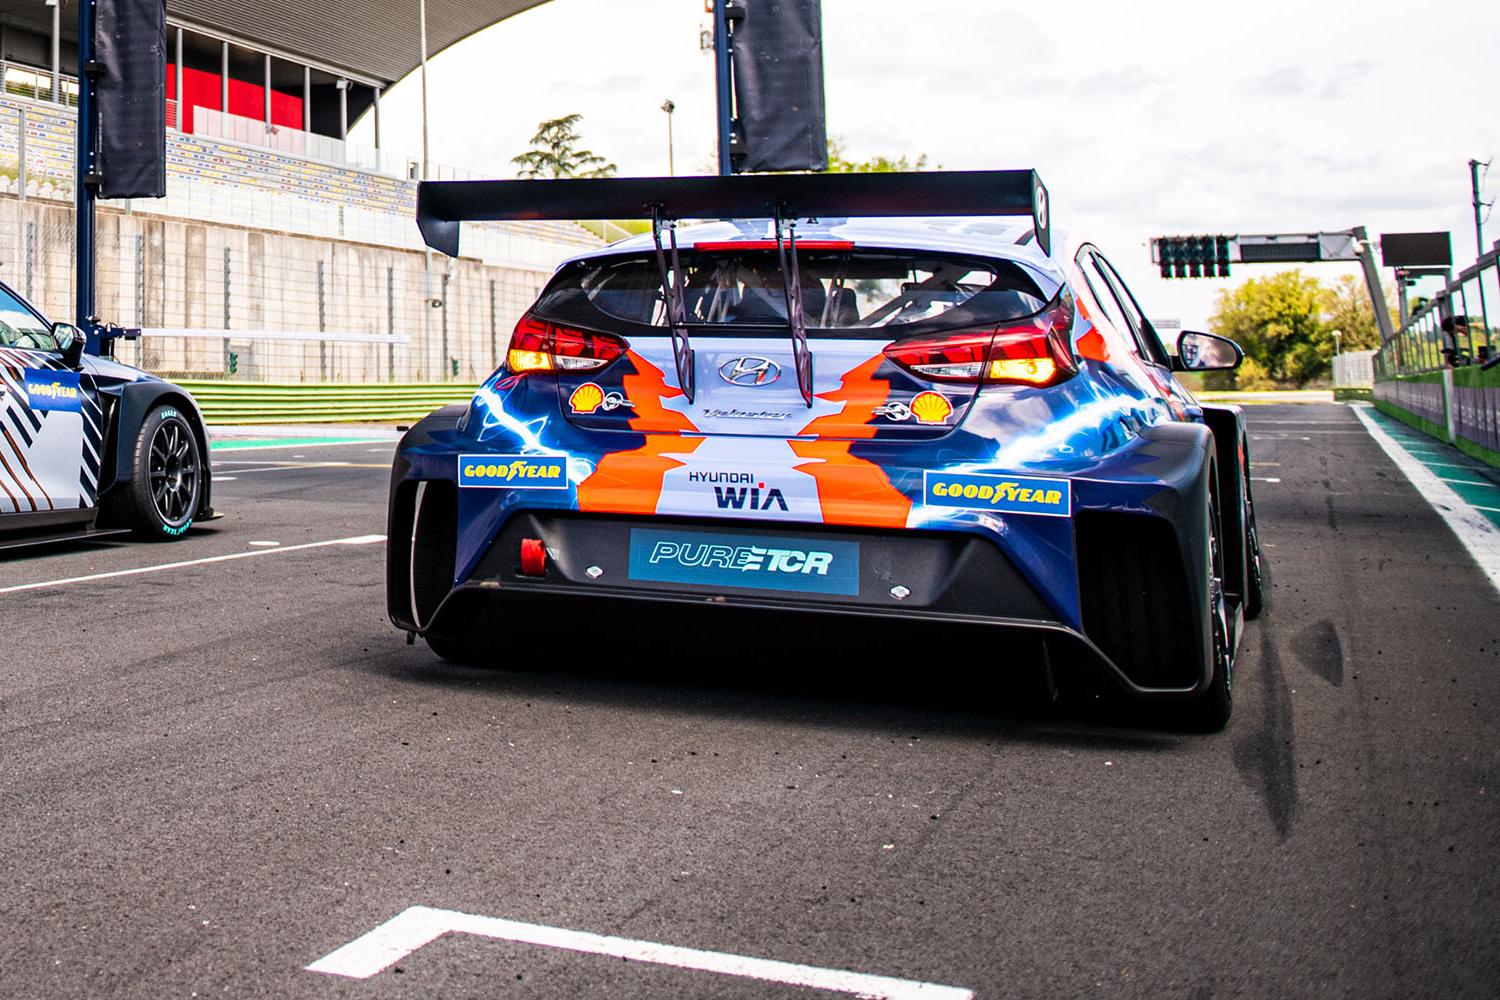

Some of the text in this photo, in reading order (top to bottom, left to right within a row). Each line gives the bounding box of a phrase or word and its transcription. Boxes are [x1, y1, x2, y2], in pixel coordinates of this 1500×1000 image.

[27, 382, 77, 399] GOODYEAR
[161, 410, 177, 419] EAGLE
[464, 461, 561, 481] GOODYEAR
[689, 471, 754, 484] HYUNDAI
[714, 482, 789, 512] WIA
[932, 482, 1062, 504] GOODYEAR
